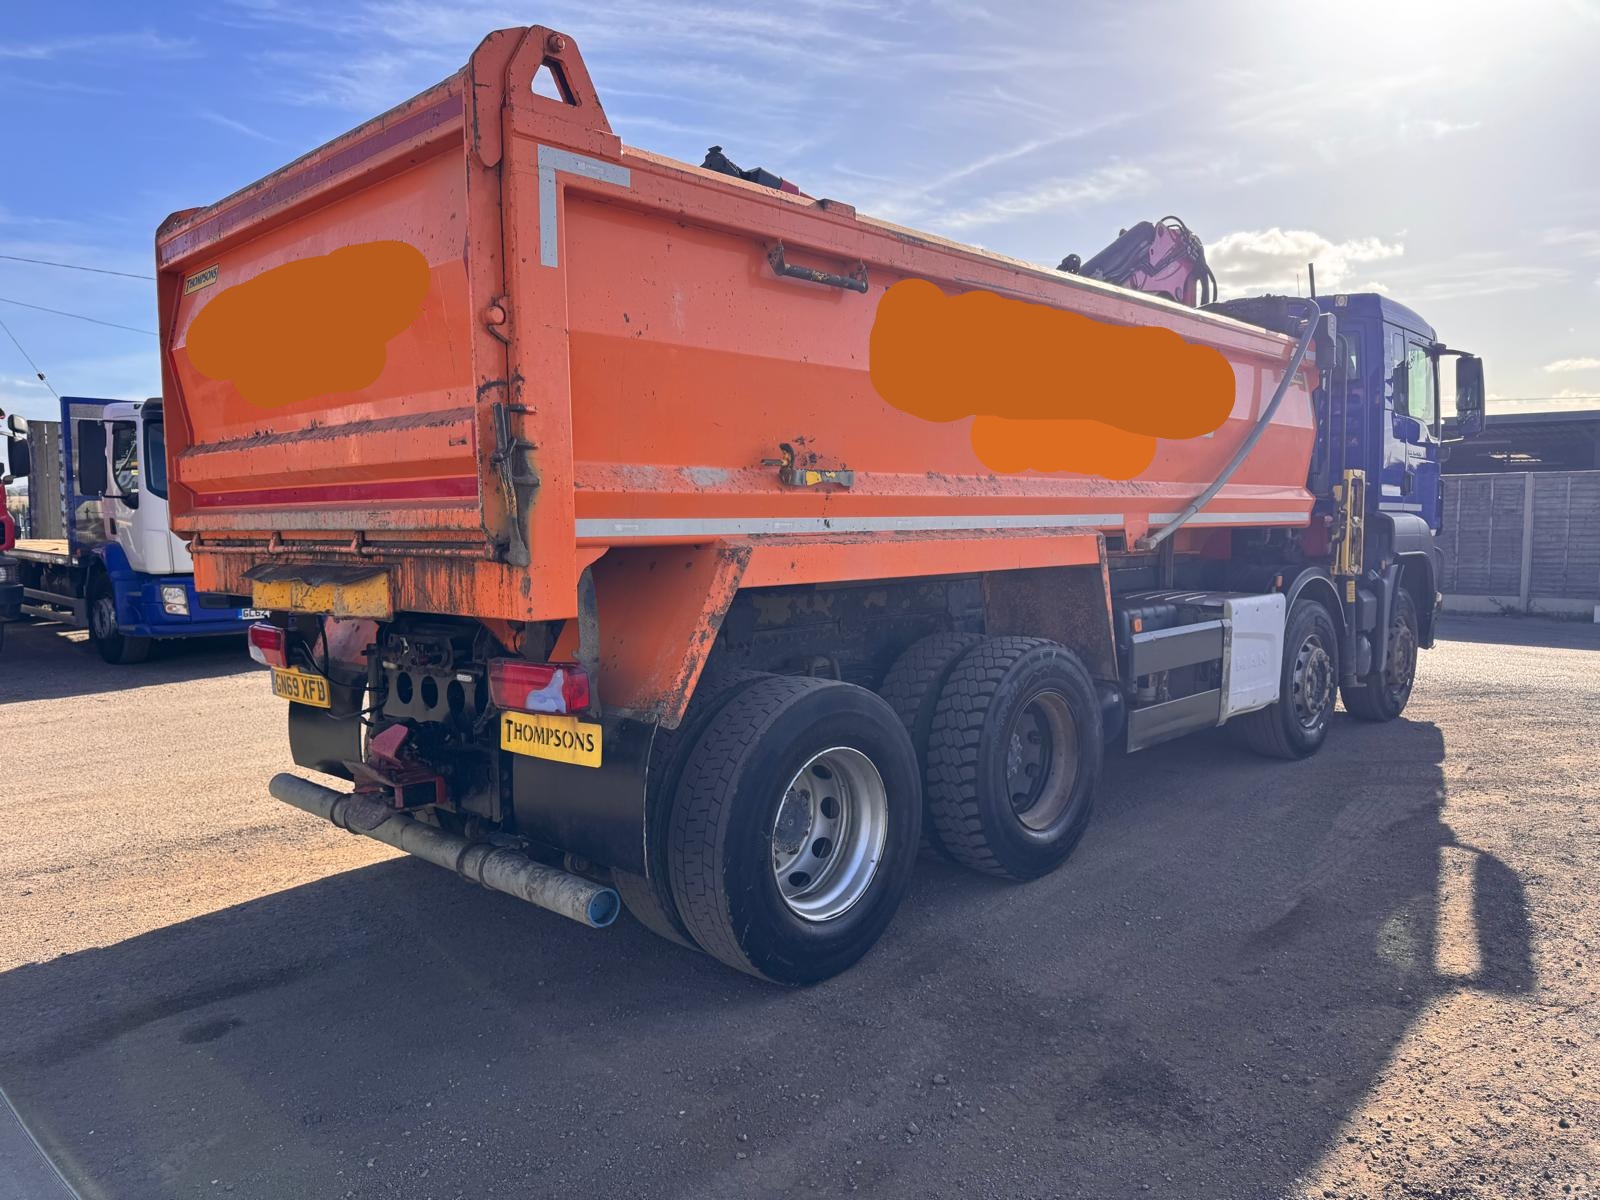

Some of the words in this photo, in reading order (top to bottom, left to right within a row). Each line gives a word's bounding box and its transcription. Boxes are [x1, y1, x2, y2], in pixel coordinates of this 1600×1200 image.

[186, 267, 218, 292] THOMPSONS
[275, 673, 300, 697] GN69
[301, 678, 326, 702] XFD
[505, 718, 595, 752] THOMPSONS
